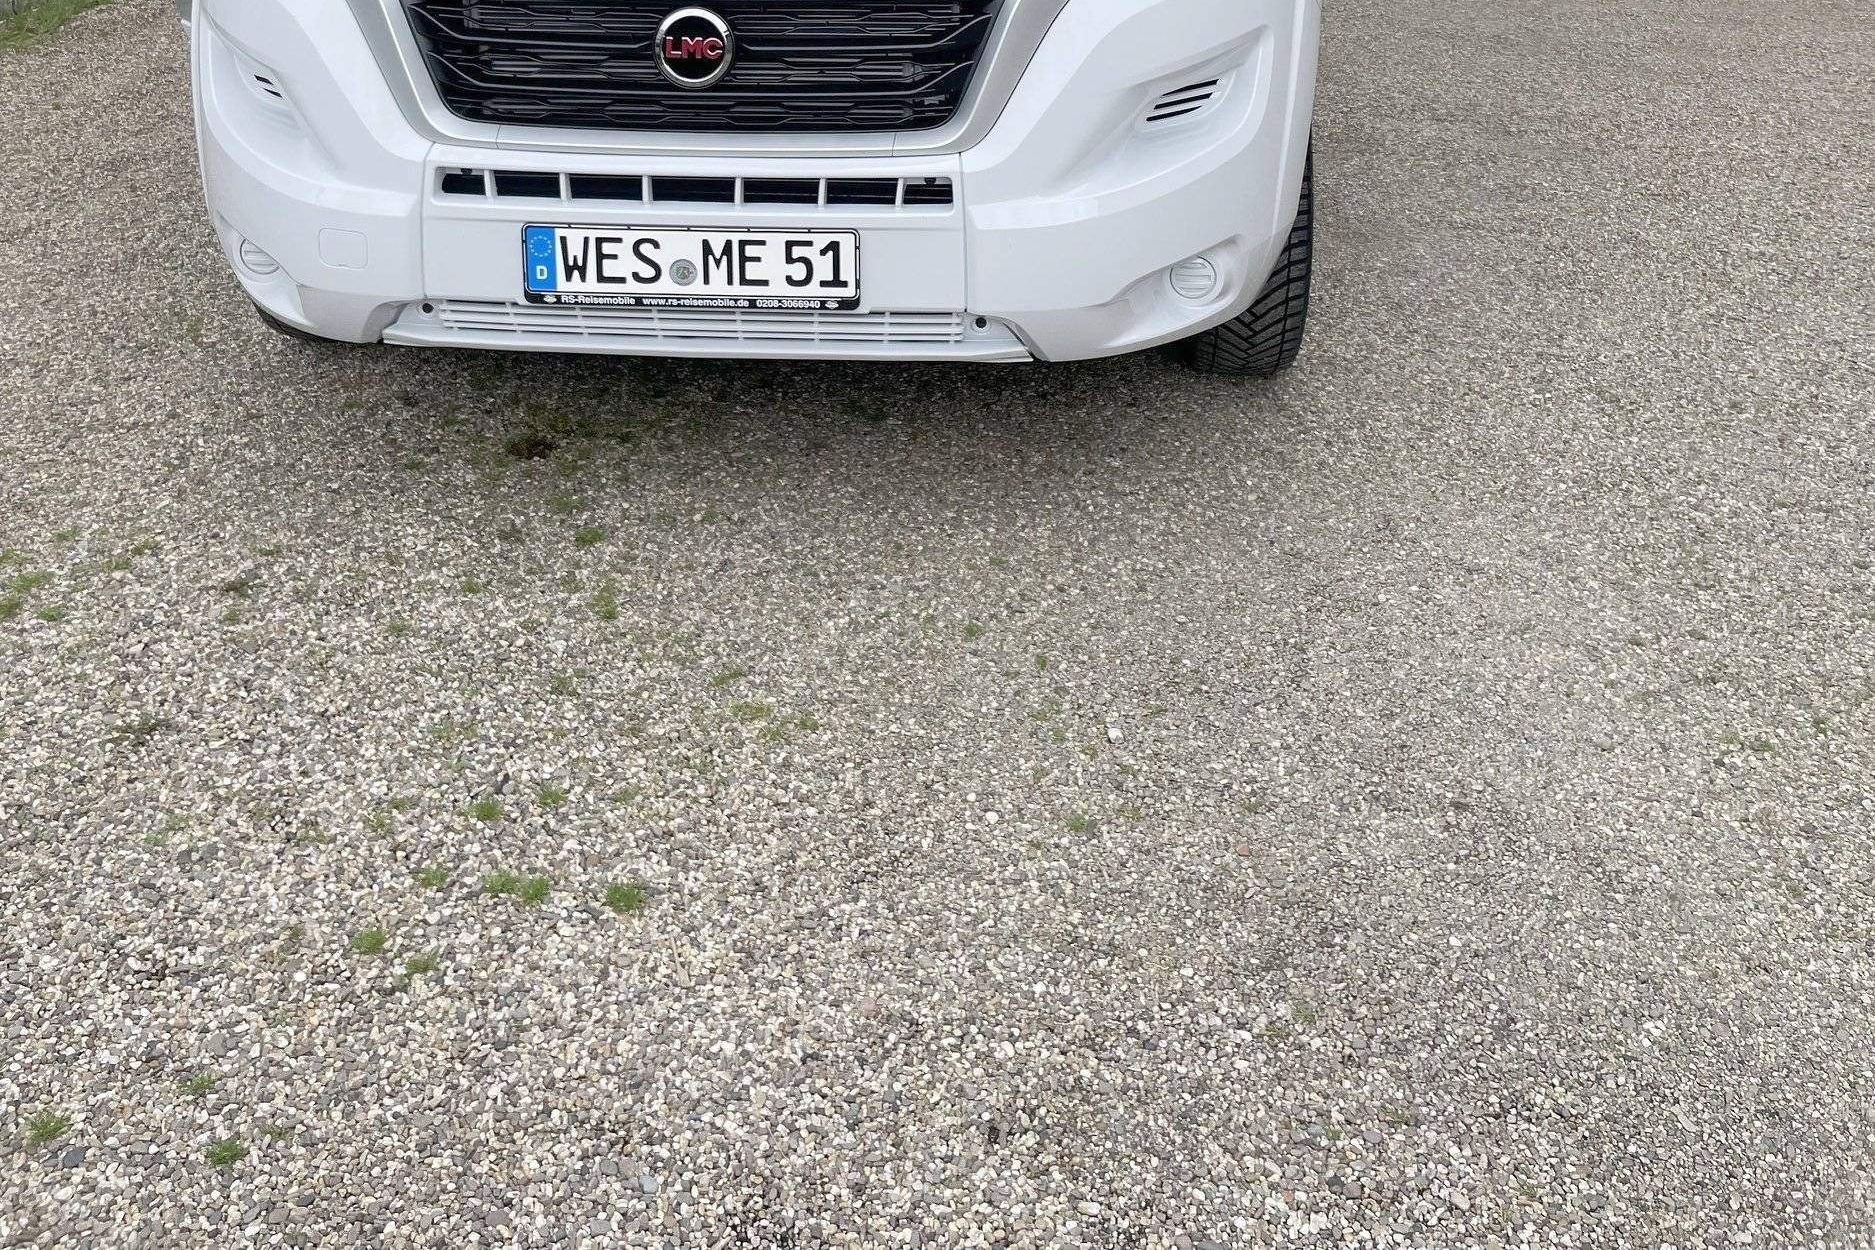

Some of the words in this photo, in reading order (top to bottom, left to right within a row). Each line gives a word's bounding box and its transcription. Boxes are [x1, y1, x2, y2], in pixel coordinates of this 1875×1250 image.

[665, 36, 723, 60] LMC
[536, 266, 548, 280] D
[560, 235, 663, 285] WES
[702, 238, 770, 287] ME
[785, 239, 849, 289] 51
[561, 294, 636, 305] RS-Reisemobile
[642, 297, 749, 308] www.rs-reisemobile.de
